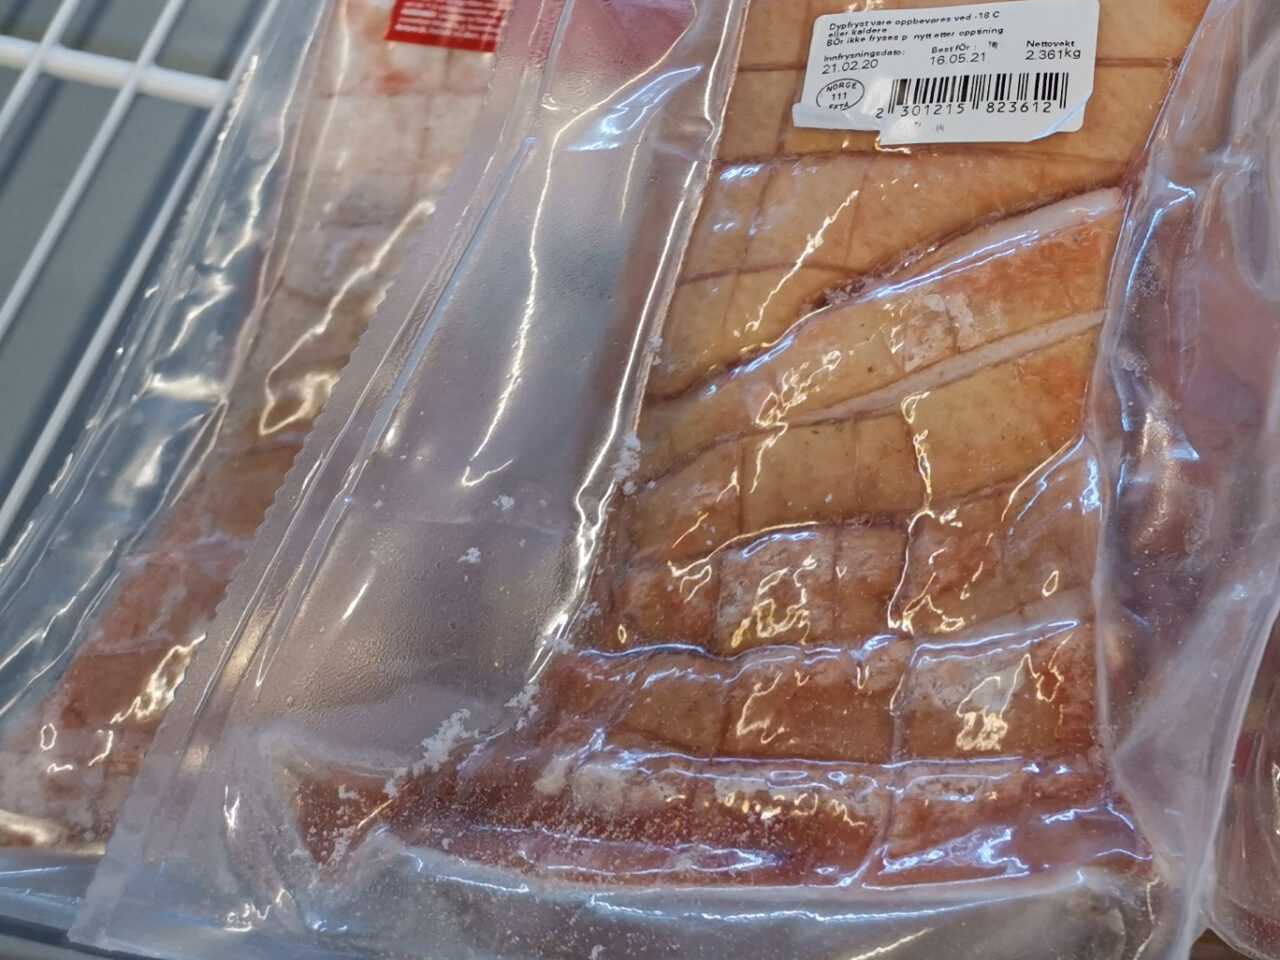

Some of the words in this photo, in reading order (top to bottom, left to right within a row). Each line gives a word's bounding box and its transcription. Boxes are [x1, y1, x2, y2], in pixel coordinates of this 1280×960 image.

[829, 21, 868, 30] Dypfryst
[895, 17, 950, 25] oppbevares
[829, 28, 848, 37] eller
[852, 27, 887, 35] kaldere
[914, 33, 931, 41] nytt
[824, 49, 905, 62] Innfrysningsdato:
[930, 52, 985, 66] 16.05.21
[1025, 49, 1081, 60] 2.361kg
[822, 59, 879, 74] 21.02.20
[827, 82, 857, 92] NORGE
[832, 92, 847, 100] 111
[876, 108, 884, 118] 2
[901, 104, 965, 116] 301215
[986, 102, 1051, 113] 823612
